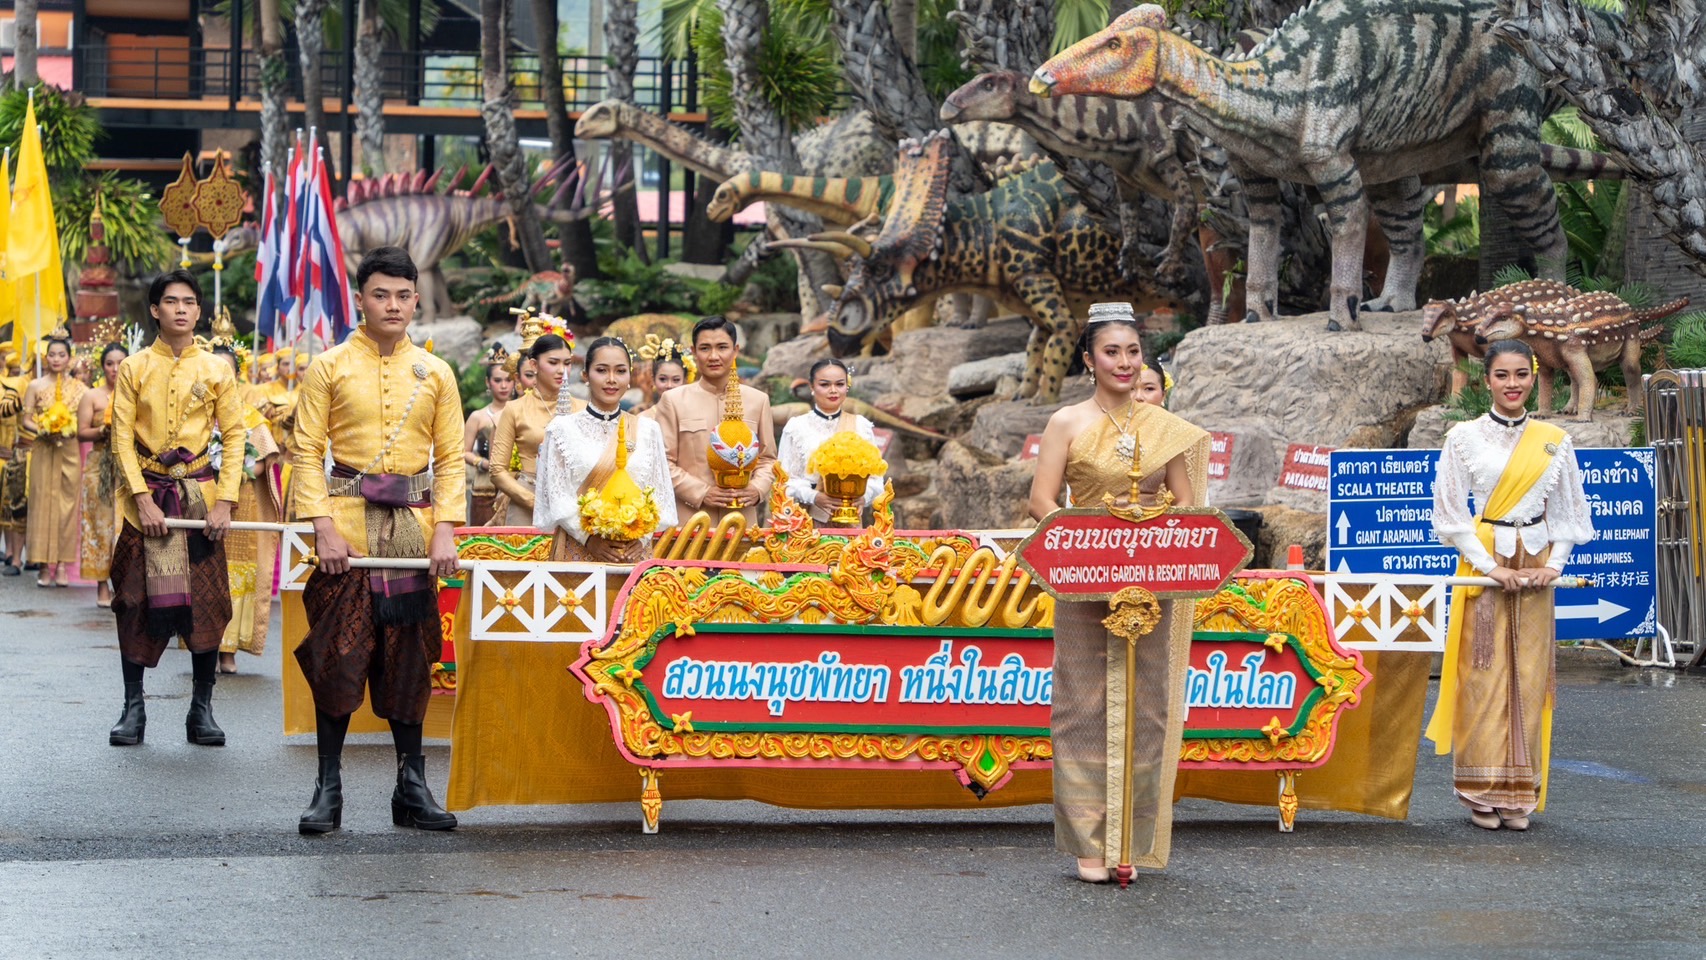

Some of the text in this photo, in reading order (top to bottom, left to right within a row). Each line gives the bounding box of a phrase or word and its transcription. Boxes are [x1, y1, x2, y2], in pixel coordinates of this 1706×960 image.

[1338, 454, 1429, 474] สกาลา เธียเตอร์
[1338, 483, 1373, 496] SCALA
[1376, 482, 1424, 495] THEATER
[1044, 519, 1218, 557] สวนนงนุชพัทยา
[1356, 529, 1424, 544] GIANT ARAPAIMA
[1603, 530, 1613, 541] AN
[1614, 528, 1650, 540] ELEPHANT
[1577, 553, 1592, 565] AND
[1593, 552, 1634, 564] HAPPINESS.
[1049, 563, 1220, 584] NONGNOOCH GARDEN & RESORT PATTAYA
[663, 653, 889, 715] สวนนงนุชพัทยา
